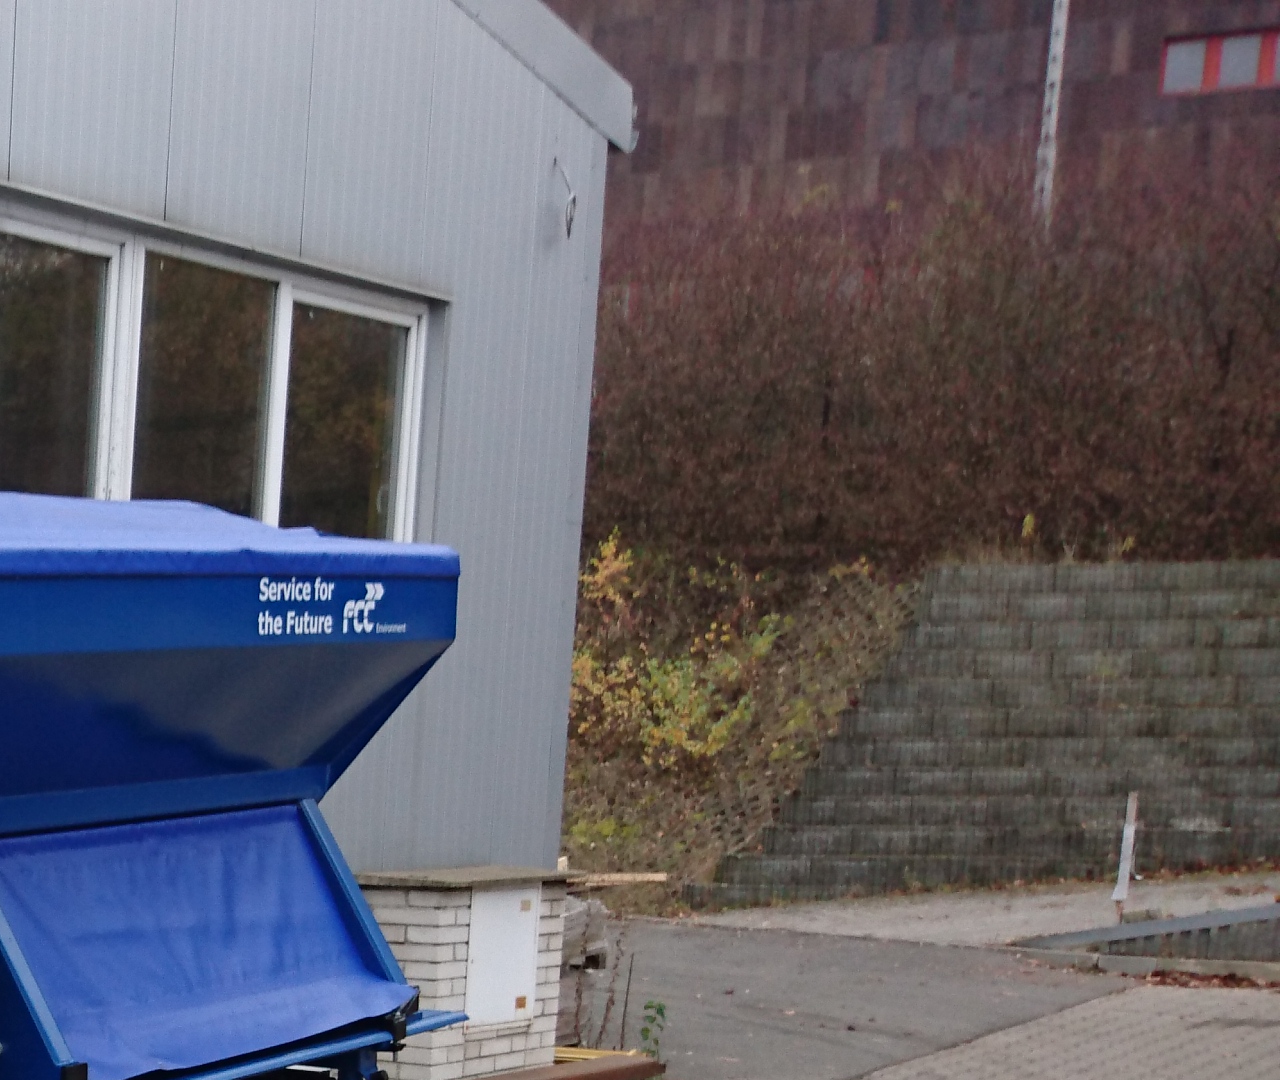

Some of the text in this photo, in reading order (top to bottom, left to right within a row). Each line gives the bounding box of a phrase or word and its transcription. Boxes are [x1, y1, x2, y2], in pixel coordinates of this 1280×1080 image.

[259, 576, 334, 602] Service for
[258, 610, 333, 635] the Future
[342, 599, 375, 634] FCC
